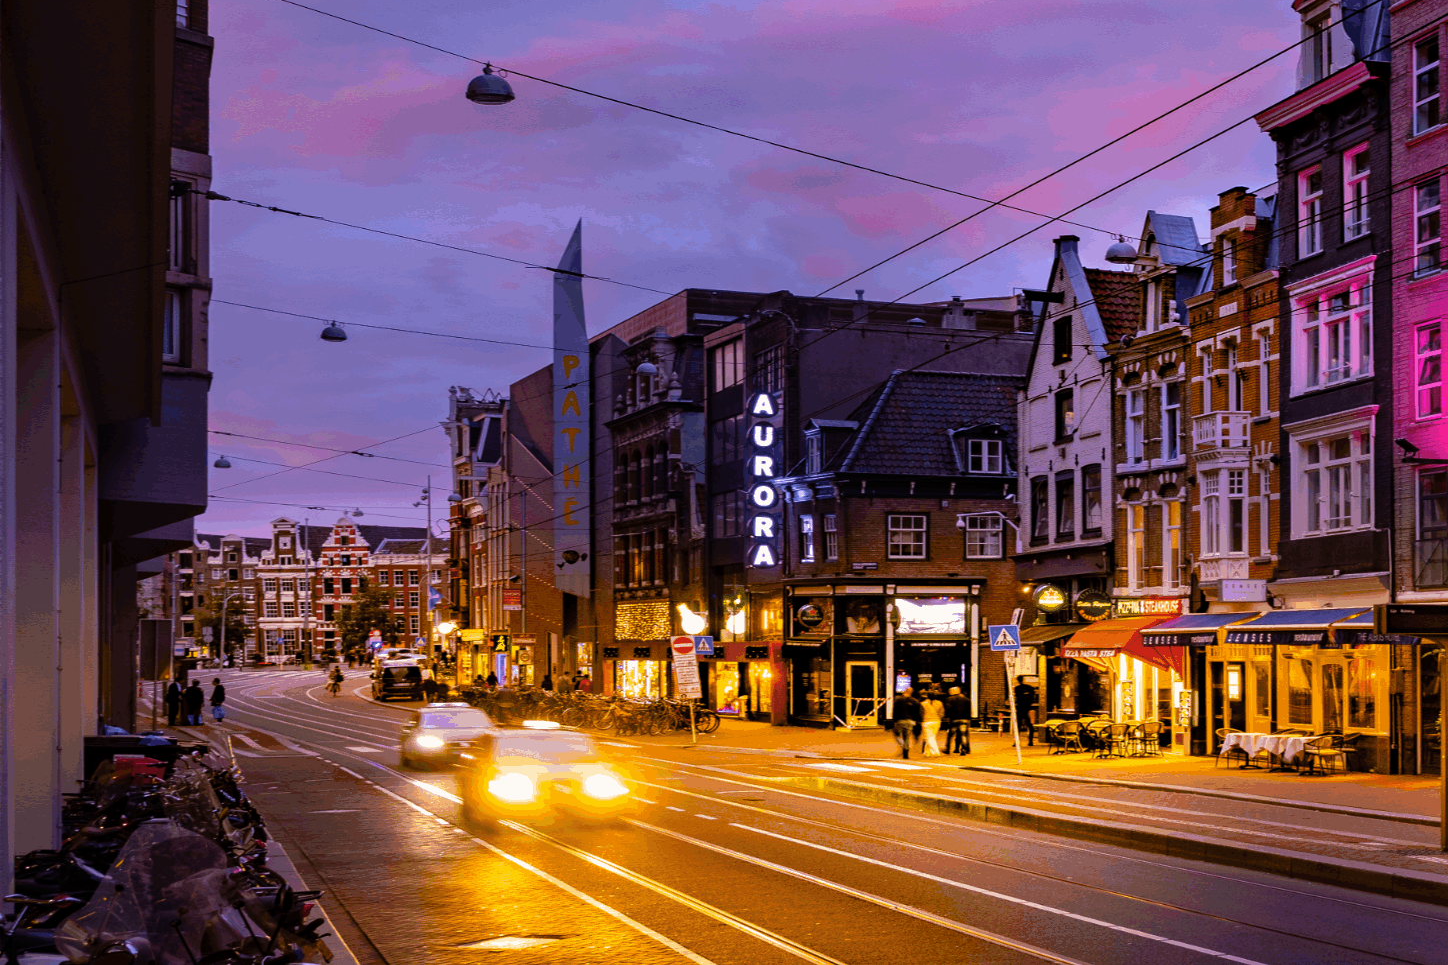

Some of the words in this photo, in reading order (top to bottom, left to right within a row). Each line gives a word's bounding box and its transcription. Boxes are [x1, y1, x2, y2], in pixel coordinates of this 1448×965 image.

[752, 393, 775, 566] AURORA
[1142, 635, 1178, 645] SENSES
[1227, 633, 1272, 643] SENSES
